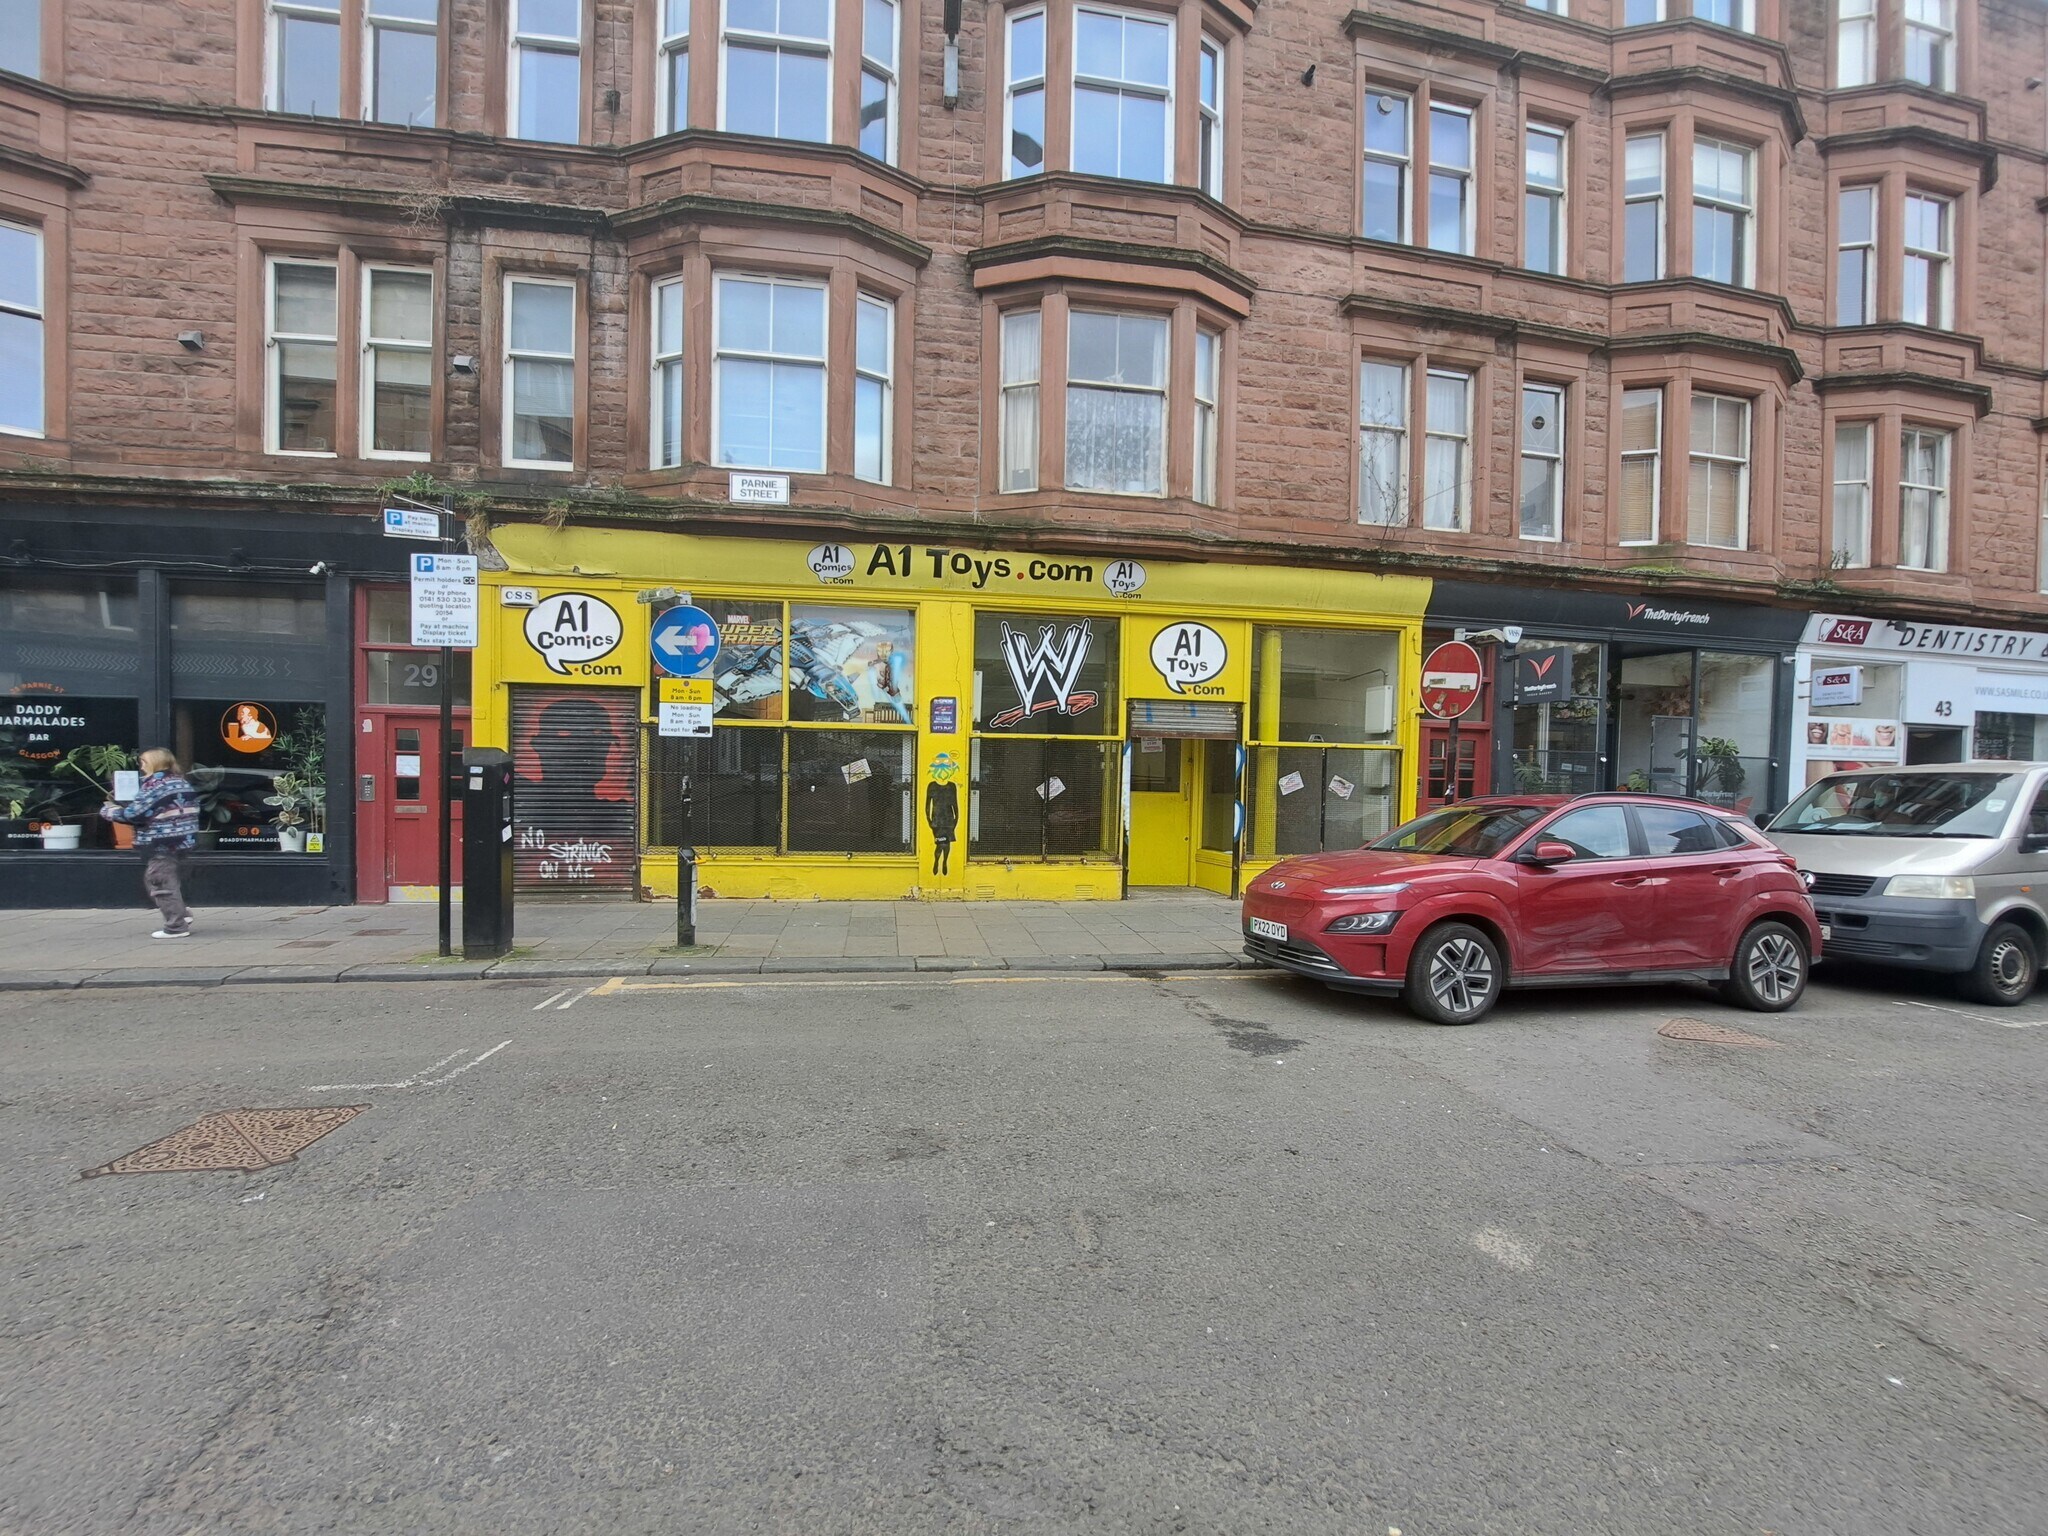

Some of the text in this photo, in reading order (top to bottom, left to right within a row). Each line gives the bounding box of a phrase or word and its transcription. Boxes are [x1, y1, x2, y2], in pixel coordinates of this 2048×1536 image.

[742, 478, 778, 488] PARNIE
[740, 488, 779, 498] STREET
[822, 545, 840, 564] A1
[866, 544, 912, 577] A1
[813, 562, 852, 573] Comics
[1116, 562, 1133, 579] A1
[1112, 579, 1136, 590] Toys
[555, 600, 588, 632] A1
[727, 614, 750, 624] MARVEL
[1644, 608, 1710, 625] TheDorkyFrench
[538, 632, 614, 649] Comics
[1834, 624, 1864, 642] S&A
[1898, 627, 2034, 656] DENTISTRY
[1174, 628, 1201, 657] A1
[404, 664, 438, 687] 29
[1166, 658, 1208, 678] Toys
[1826, 676, 1848, 684] S&A
[16, 704, 62, 715] DADDY
[1934, 700, 1952, 716] 43
[0, 716, 86, 727] ARMALADES
[18, 749, 60, 759] GLASGOW
[521, 826, 545, 849] NO
[539, 860, 558, 879] ON
[1254, 919, 1270, 934] PX22
